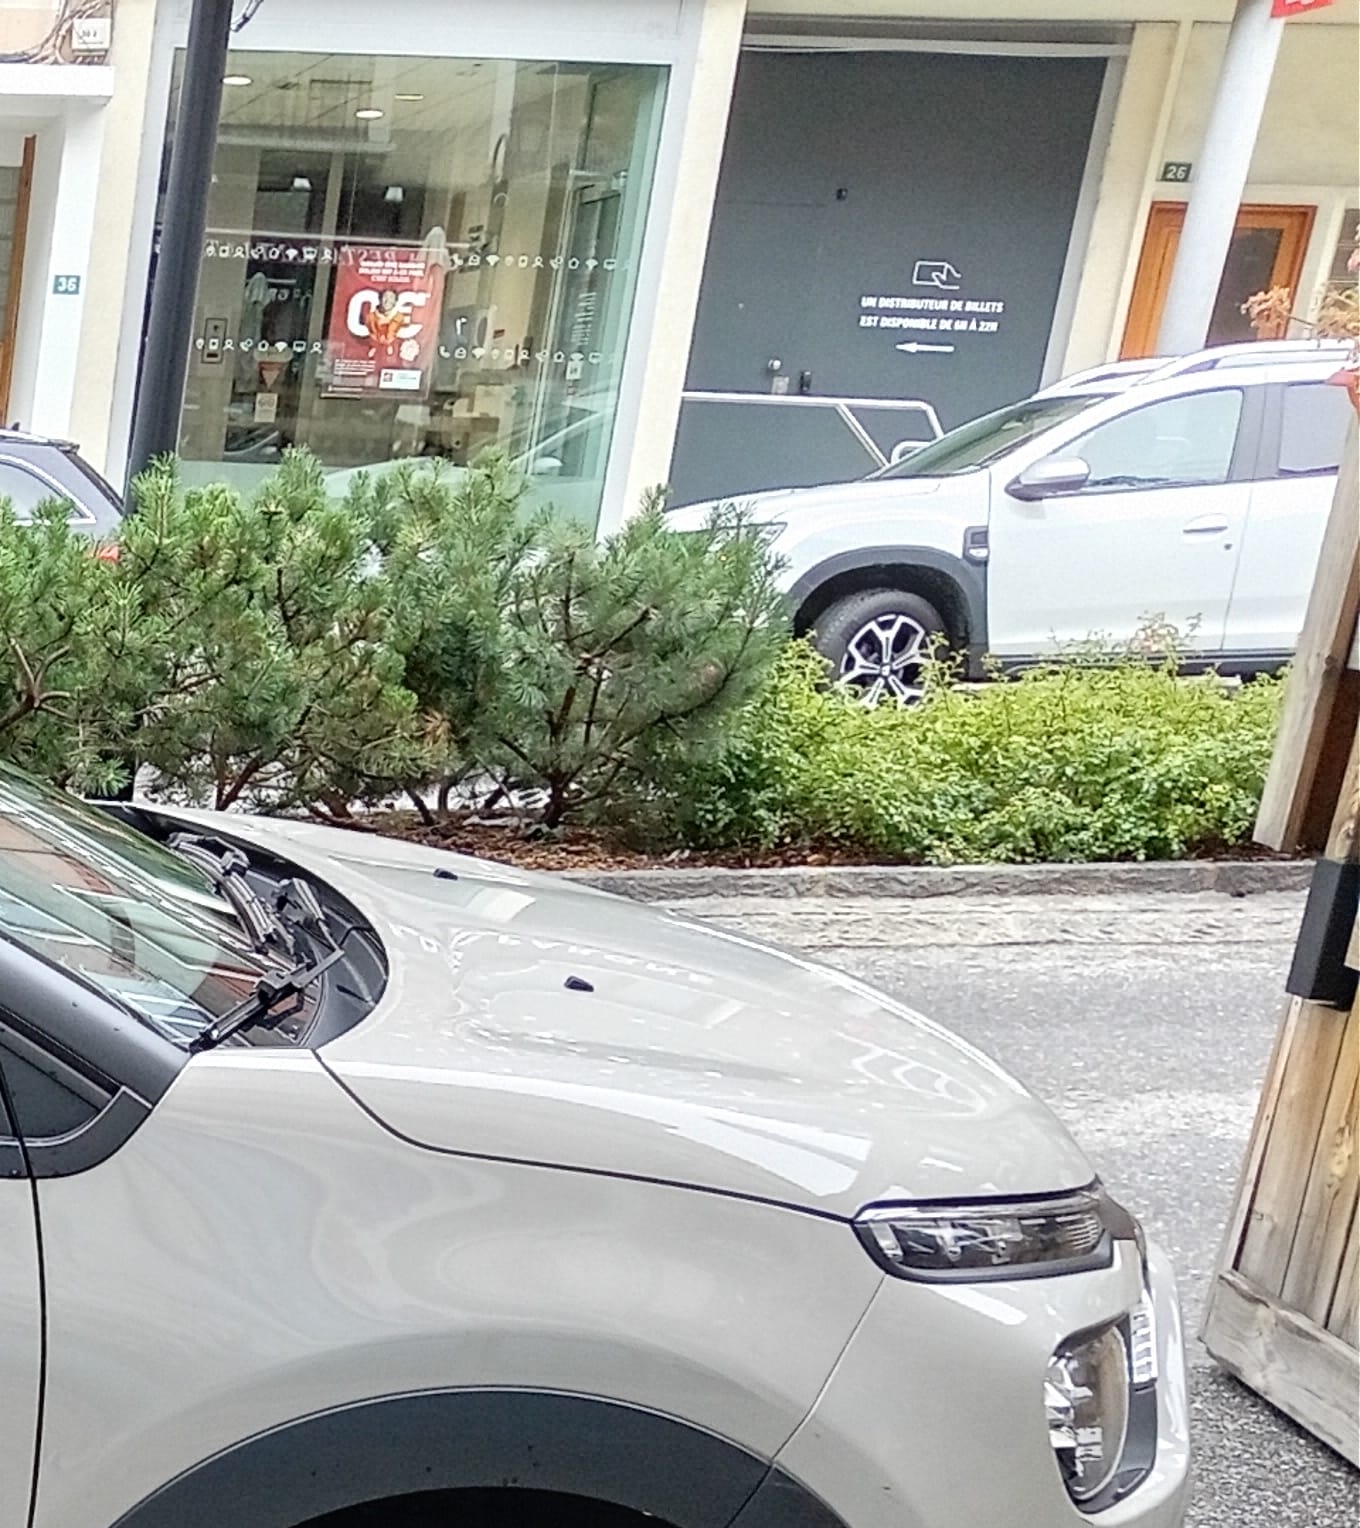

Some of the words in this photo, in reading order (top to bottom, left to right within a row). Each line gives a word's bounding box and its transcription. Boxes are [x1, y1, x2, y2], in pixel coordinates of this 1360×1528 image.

[1166, 165, 1187, 179] 26
[57, 276, 77, 292] 36
[860, 296, 877, 308] UN
[878, 297, 948, 310] DISTRIBUTEUR
[949, 300, 963, 311] DE
[964, 300, 1004, 313] BILLETS
[859, 315, 878, 327] EST
[880, 316, 938, 330] DISPONIBLE
[939, 319, 953, 331] DE
[968, 317, 977, 332] À
[978, 321, 998, 332] 22H
